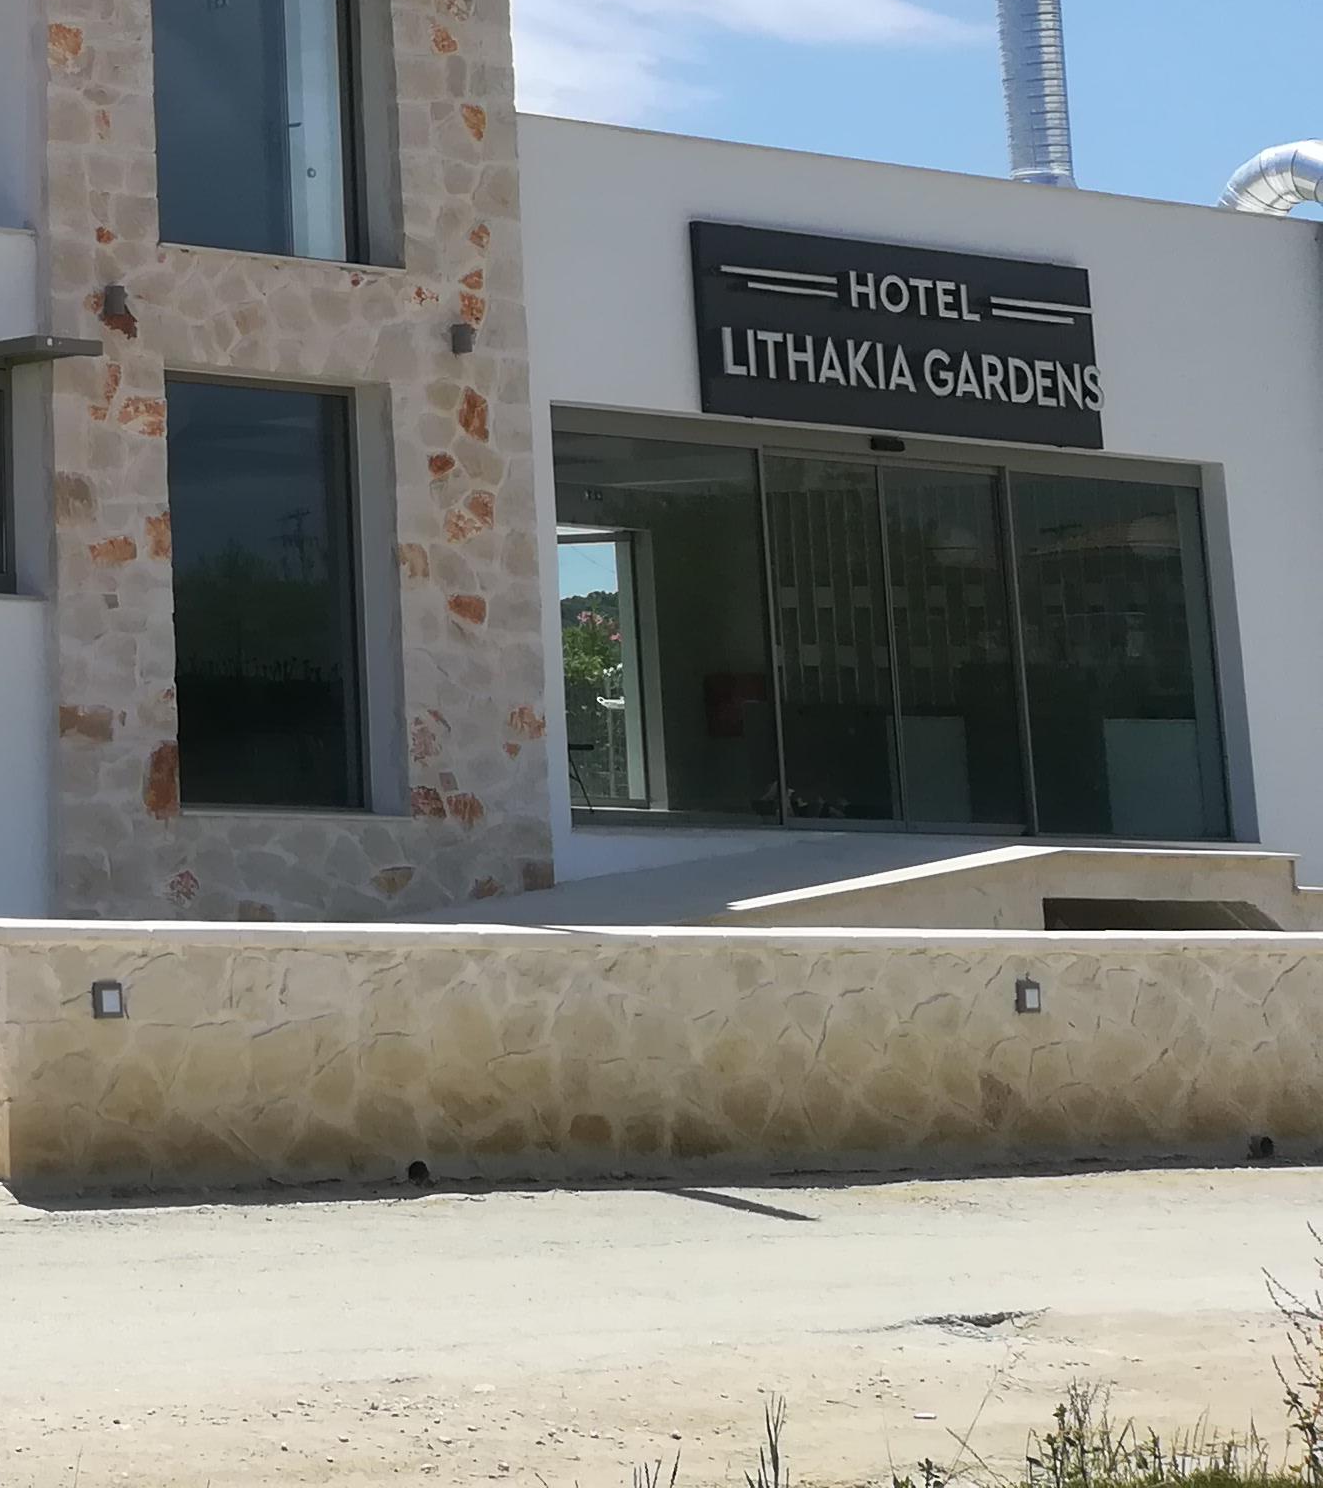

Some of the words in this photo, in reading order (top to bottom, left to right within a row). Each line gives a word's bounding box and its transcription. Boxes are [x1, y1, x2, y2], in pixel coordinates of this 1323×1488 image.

[849, 270, 981, 322] HOTEL
[721, 327, 917, 393] LITHAKIA
[923, 347, 1106, 412] GARDENS
